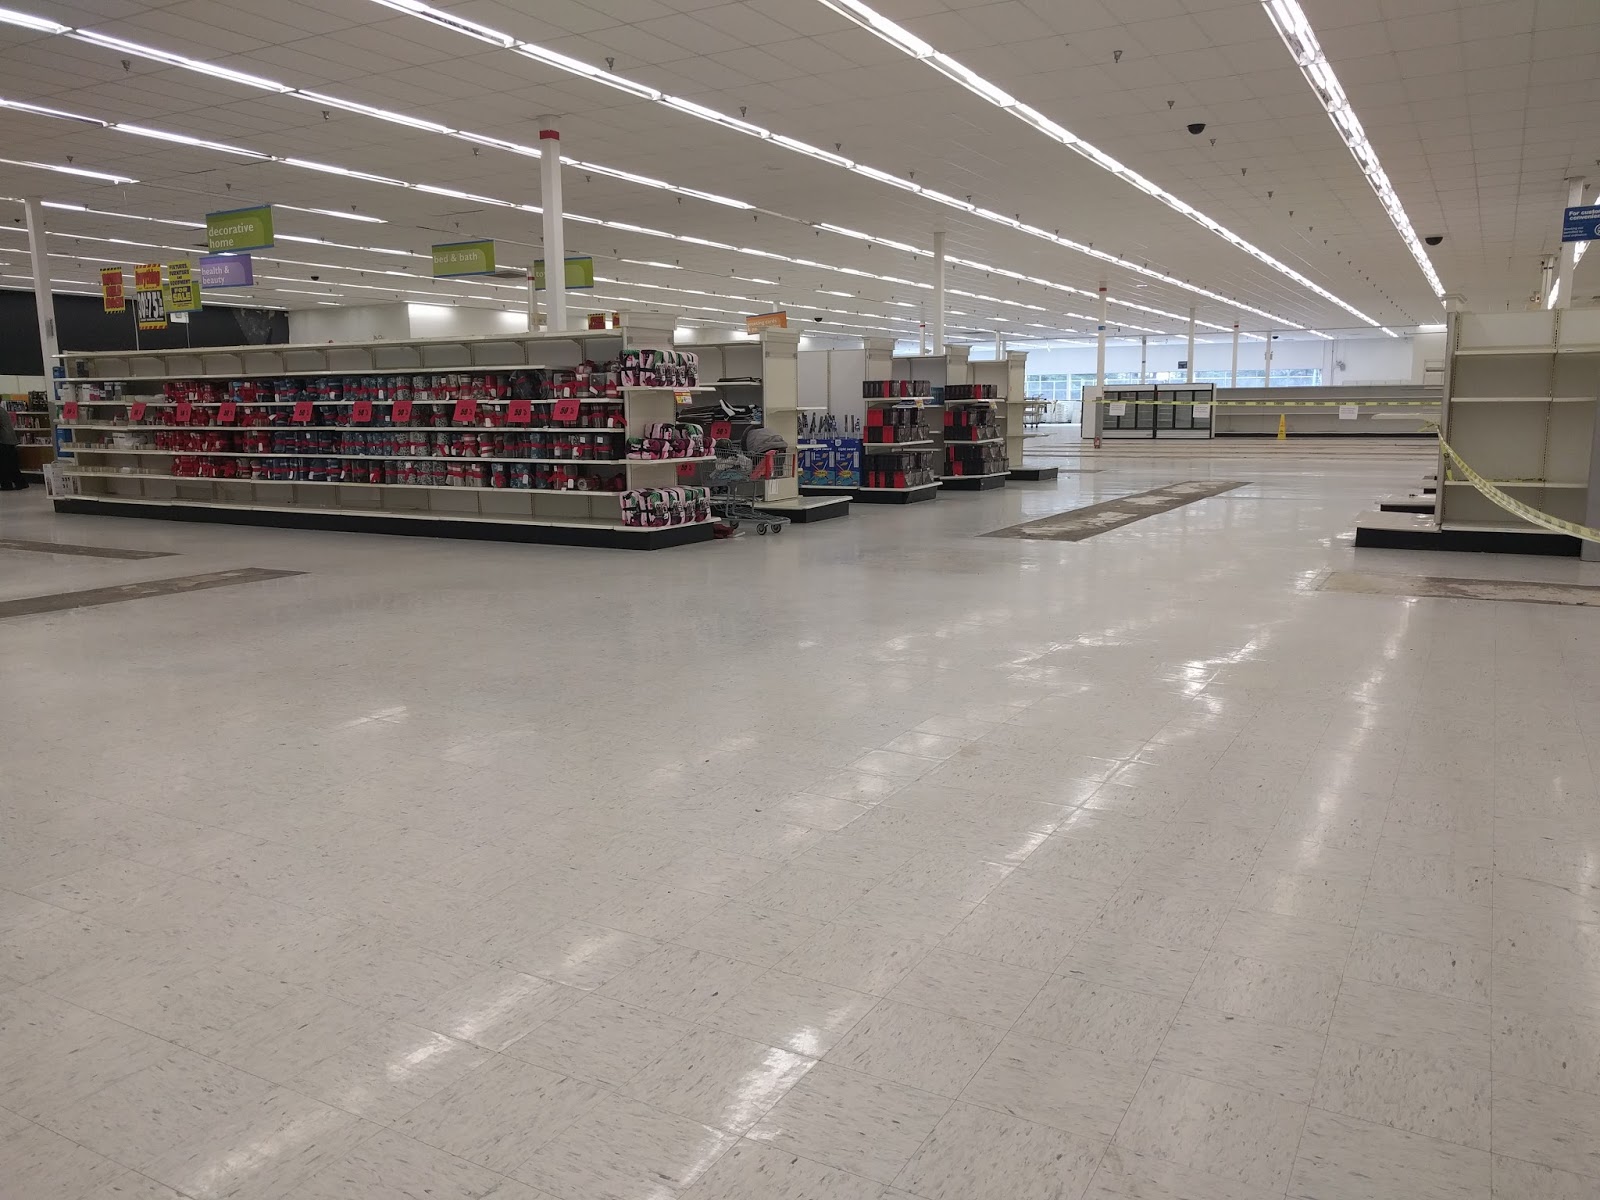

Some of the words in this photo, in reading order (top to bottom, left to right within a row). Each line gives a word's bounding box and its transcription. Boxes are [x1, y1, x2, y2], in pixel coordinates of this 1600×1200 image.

[208, 222, 254, 237] decorative
[209, 238, 234, 249] home
[433, 253, 449, 264] bed
[450, 253, 457, 262] &
[459, 252, 478, 261] bath
[201, 266, 223, 276] health
[224, 265, 230, 274] &
[202, 277, 225, 286] beauty
[173, 292, 191, 302] SALE
